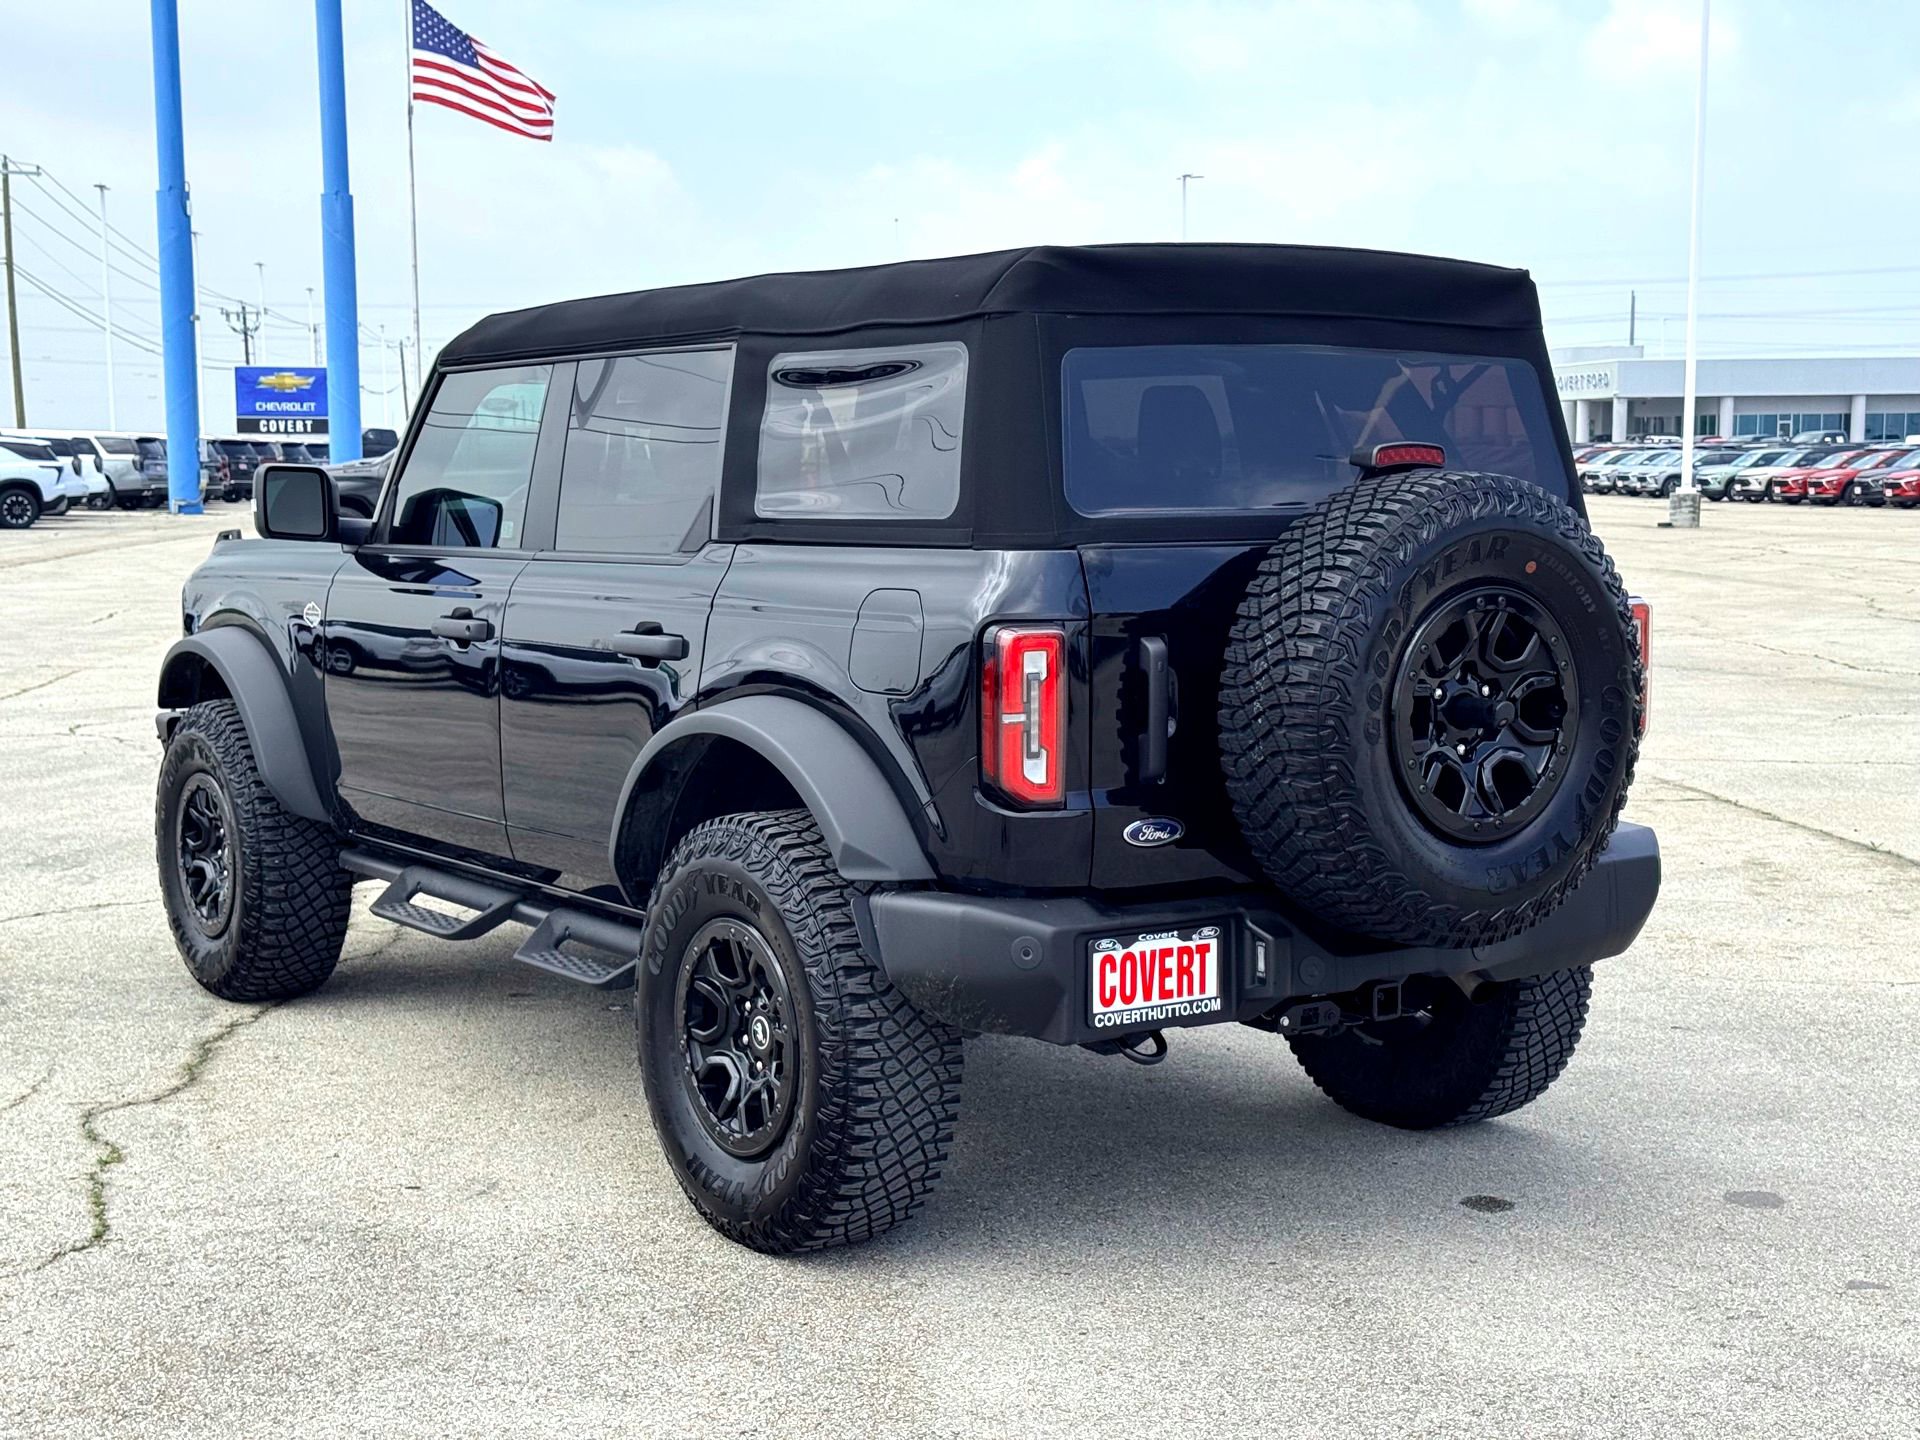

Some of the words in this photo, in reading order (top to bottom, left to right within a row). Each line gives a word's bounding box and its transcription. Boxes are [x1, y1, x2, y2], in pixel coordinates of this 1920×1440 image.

[1555, 374, 1585, 391] OVERT
[1586, 372, 1609, 389] FORD
[255, 402, 316, 412] CHEVROLET
[259, 419, 313, 433] COVERT
[1138, 824, 1171, 841] Ford
[1138, 930, 1179, 942] Covert
[1099, 943, 1211, 1008] COVERT
[1094, 998, 1221, 1028] COVERTHUTTO.COM
